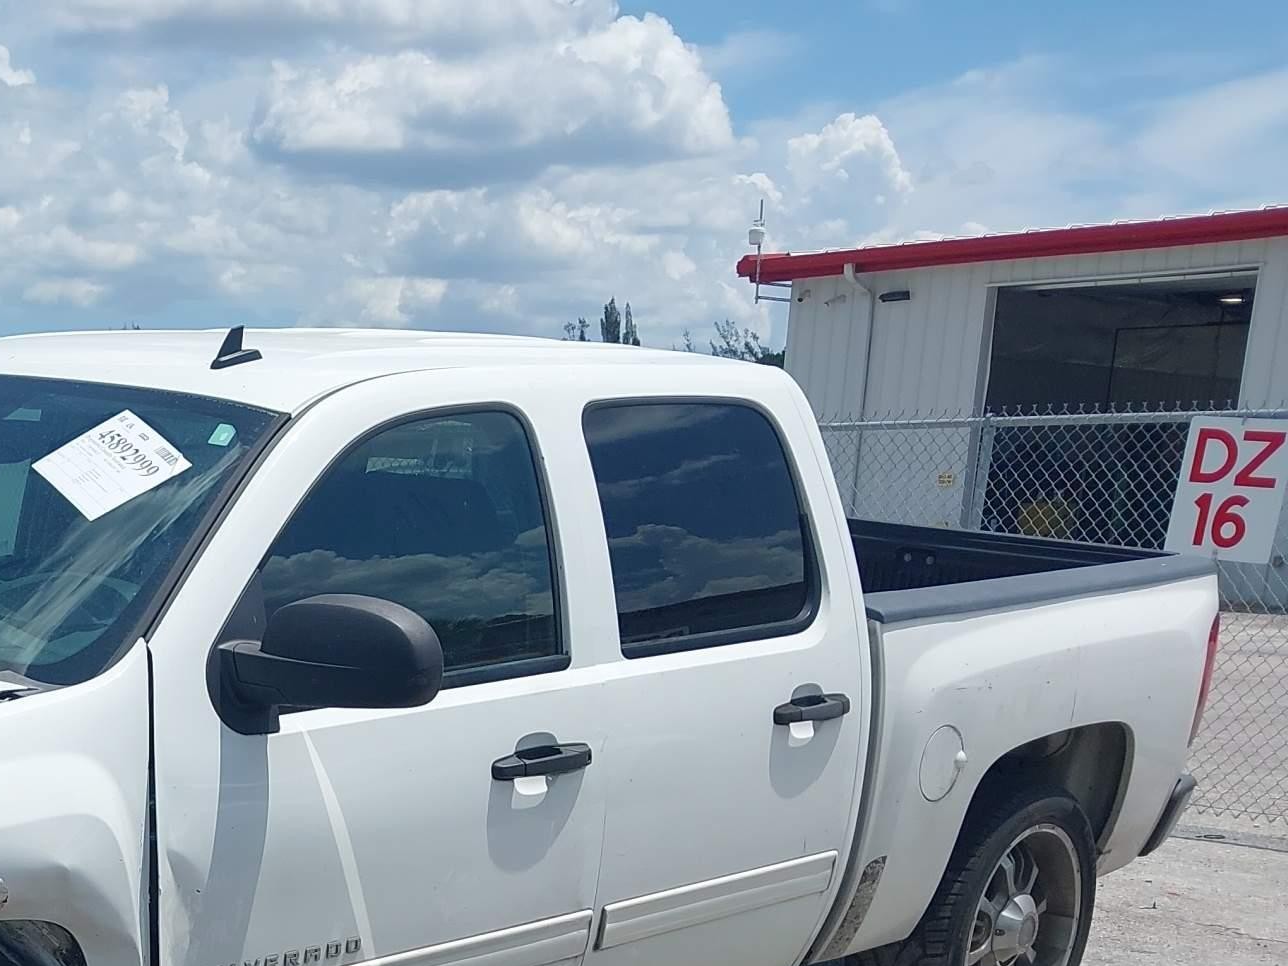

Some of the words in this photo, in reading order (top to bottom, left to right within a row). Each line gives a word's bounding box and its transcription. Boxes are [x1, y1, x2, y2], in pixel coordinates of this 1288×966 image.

[96, 429, 160, 477] 45892999
[1189, 427, 1287, 489] DZ
[1193, 492, 1251, 549] 16
